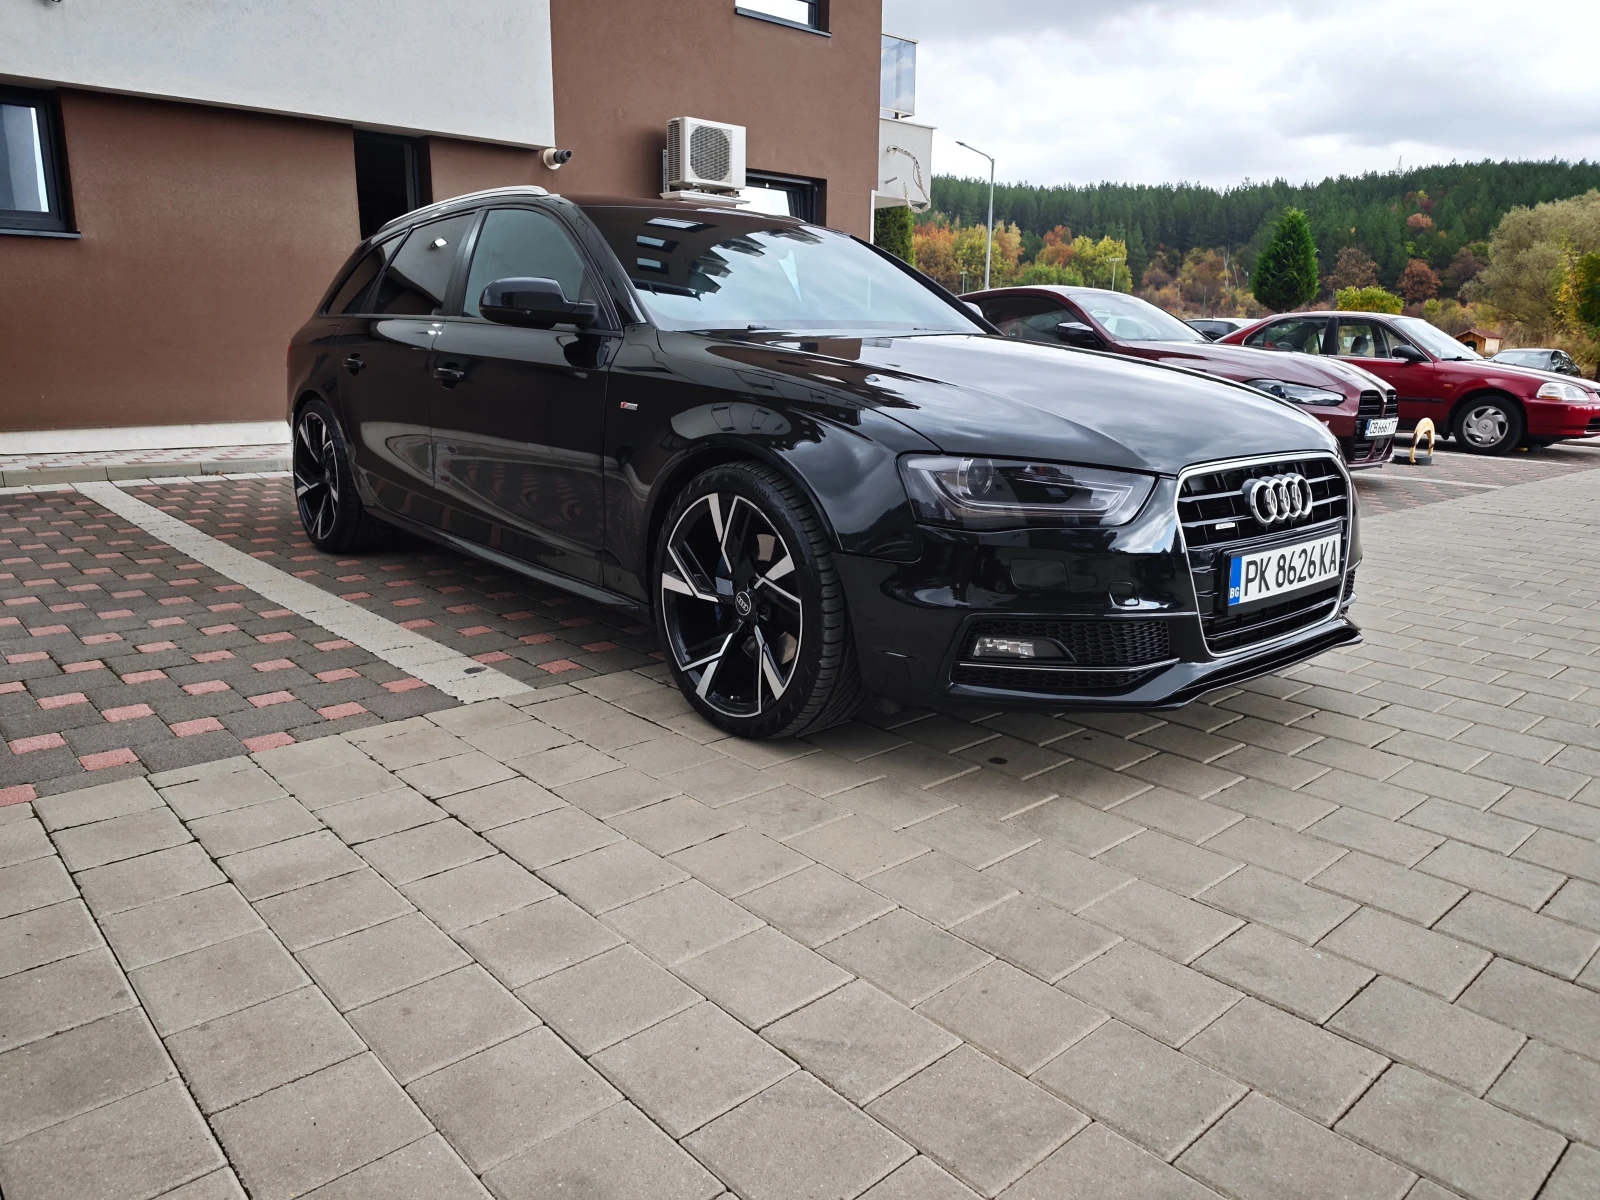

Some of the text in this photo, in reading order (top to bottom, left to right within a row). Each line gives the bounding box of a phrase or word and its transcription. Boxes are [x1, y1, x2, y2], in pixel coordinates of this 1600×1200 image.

[1244, 539, 1337, 596] PK 8626 KA
[1230, 587, 1240, 599] BG
